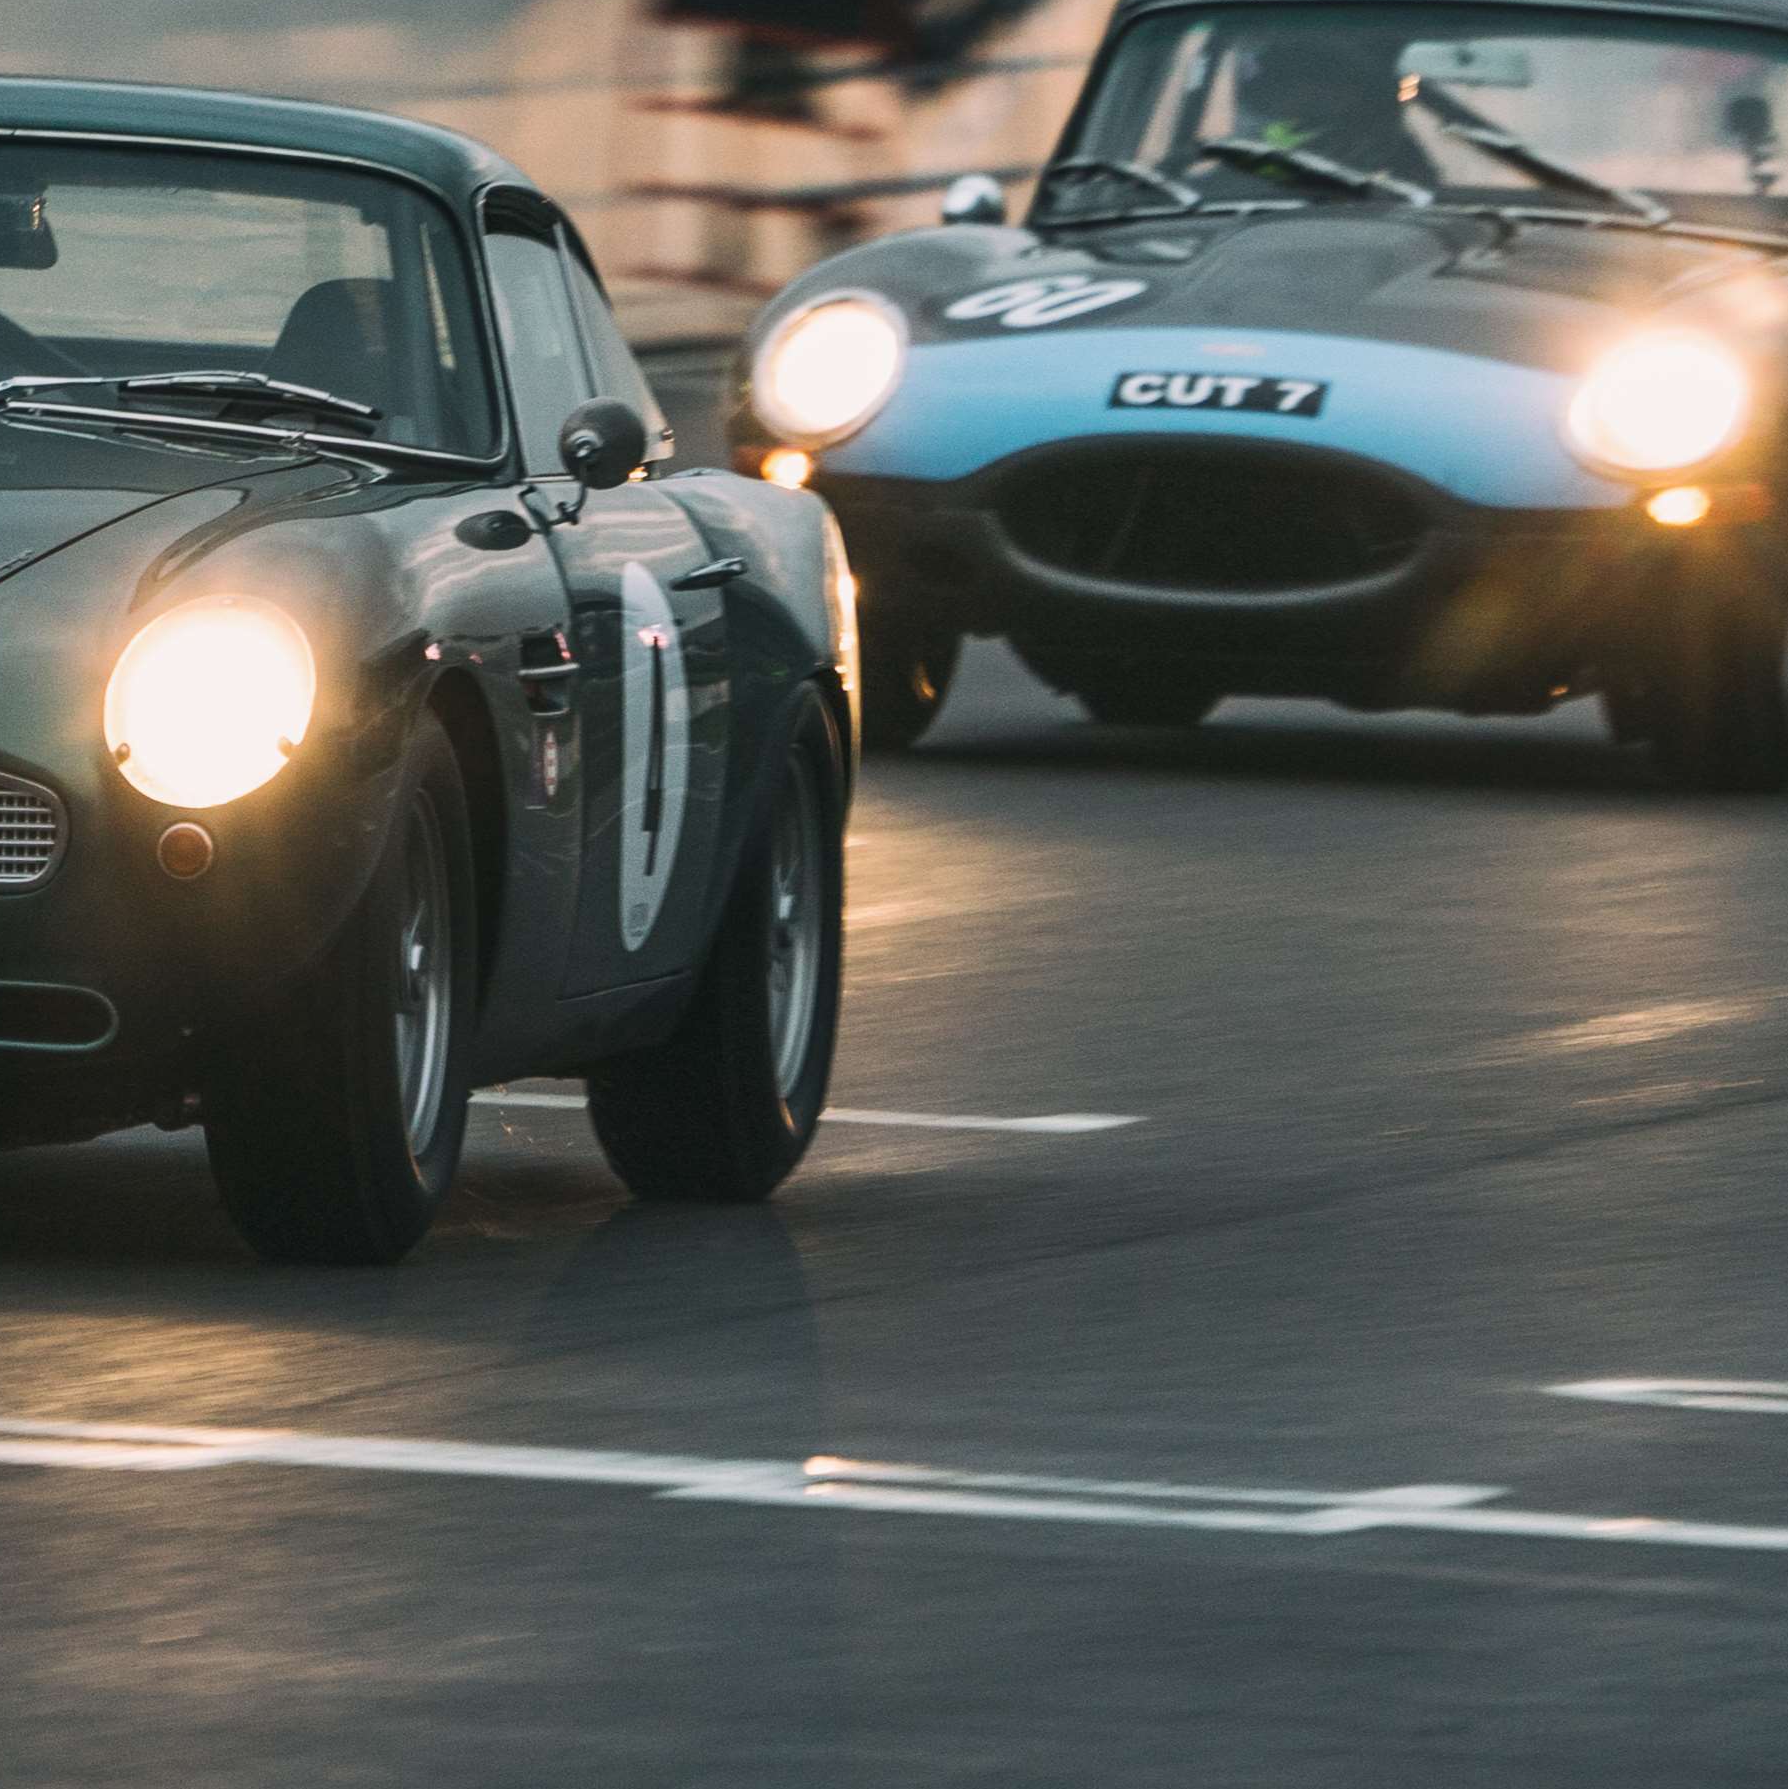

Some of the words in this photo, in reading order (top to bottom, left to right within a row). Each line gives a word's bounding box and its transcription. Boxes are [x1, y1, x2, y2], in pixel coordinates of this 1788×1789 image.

[943, 274, 1150, 328] 60
[1118, 374, 1262, 407] CUT
[1275, 380, 1319, 412] 7
